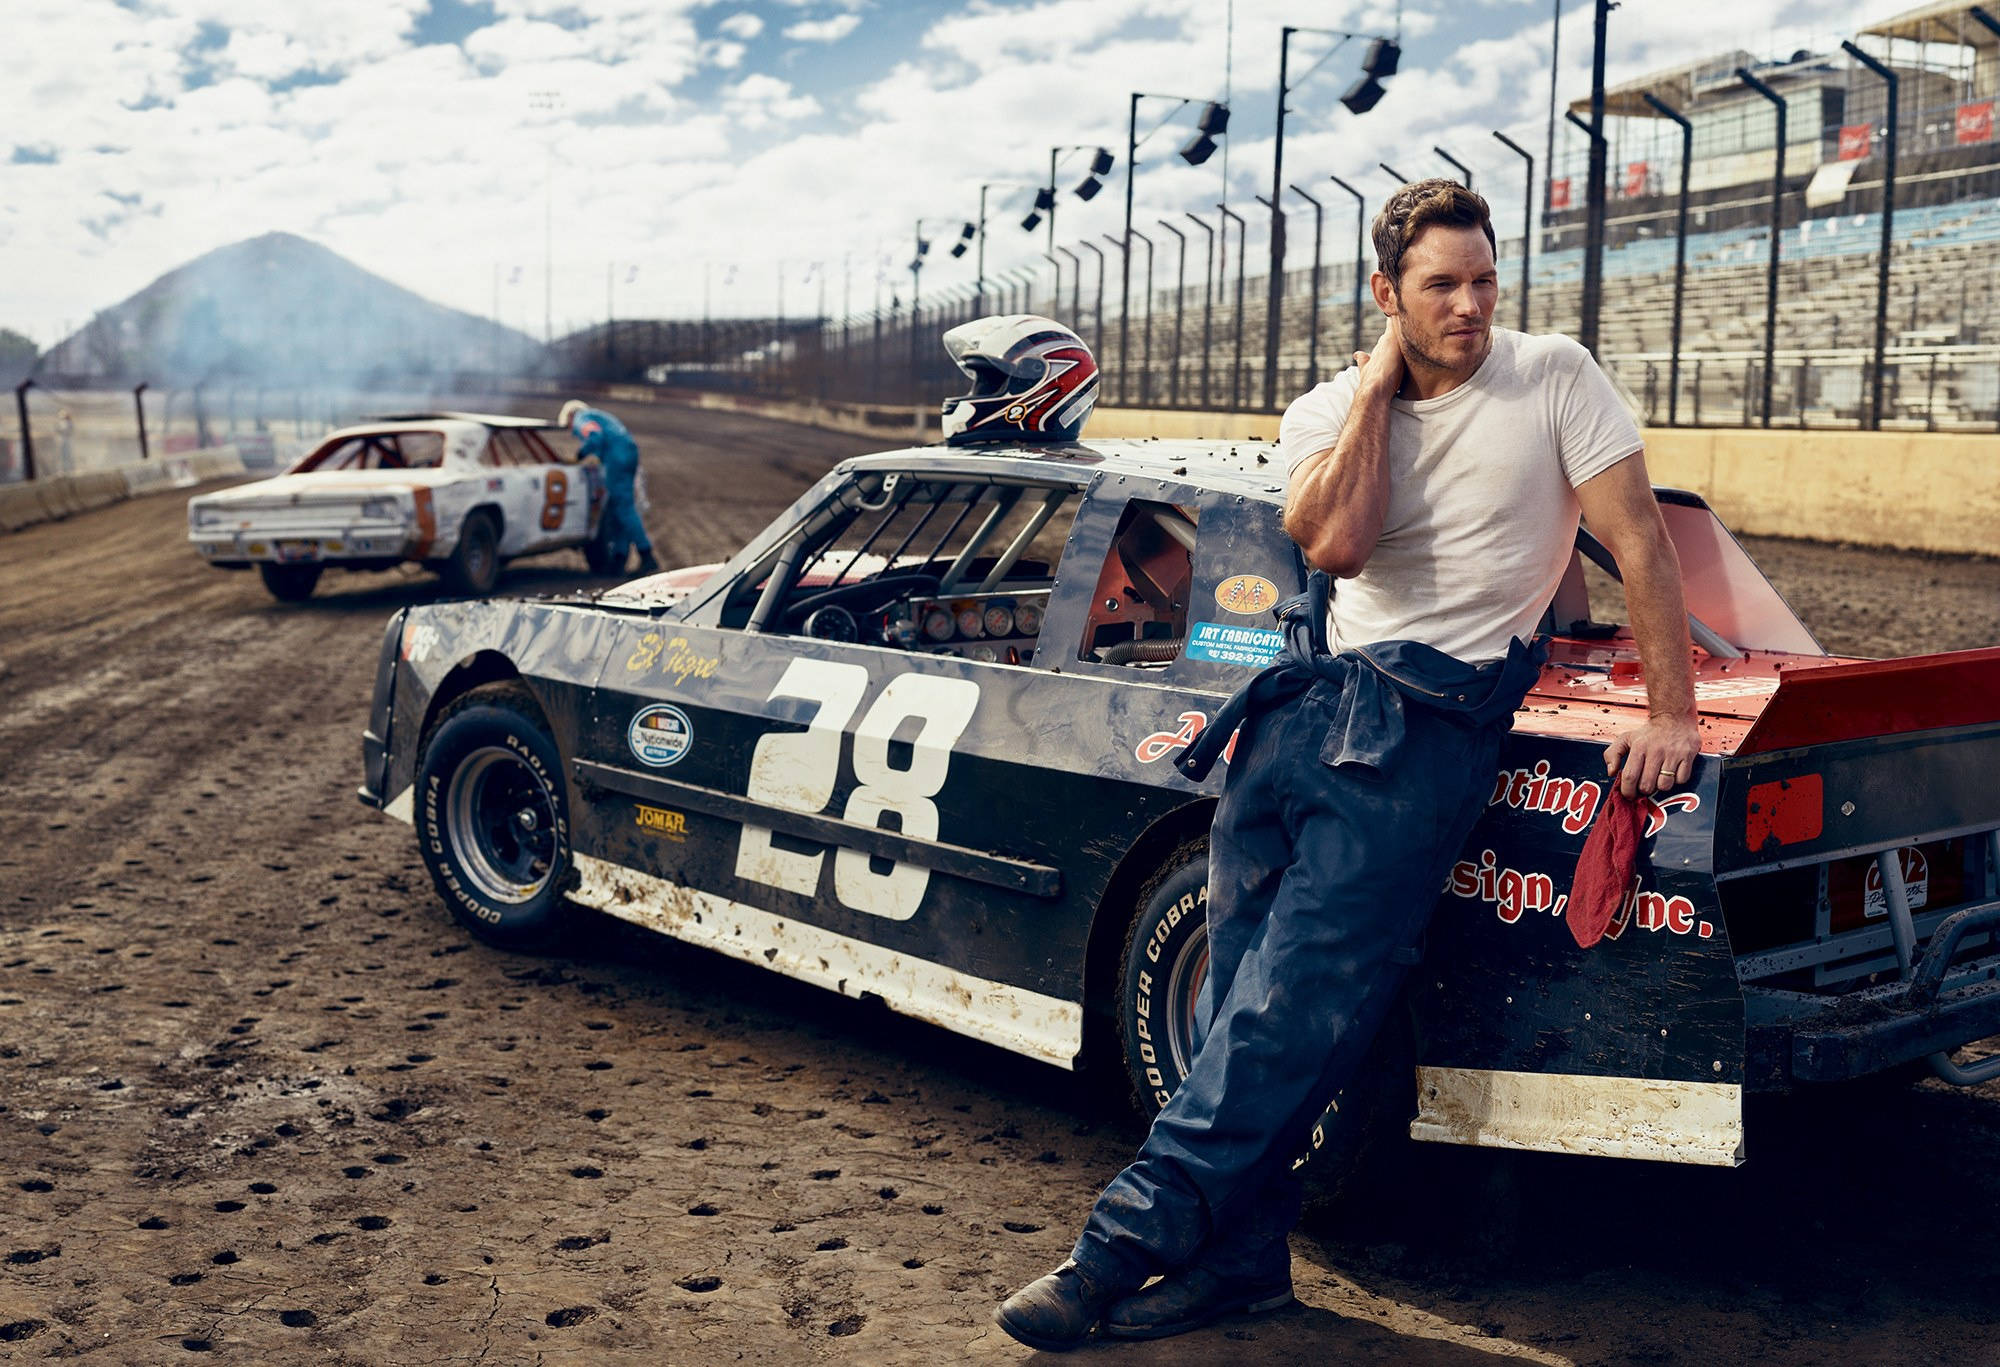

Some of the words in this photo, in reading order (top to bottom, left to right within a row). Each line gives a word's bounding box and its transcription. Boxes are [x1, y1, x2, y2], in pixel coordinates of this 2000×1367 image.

[541, 469, 567, 531] 8
[662, 636, 718, 687] Tigre
[425, 774, 444, 855] COBRA
[633, 803, 688, 834] JOMAR
[734, 656, 980, 921] 28
[438, 862, 503, 925] COOPER
[1146, 885, 1209, 963] COBRA
[1441, 849, 1568, 924] sign,
[1137, 969, 1171, 1109] COOPER
